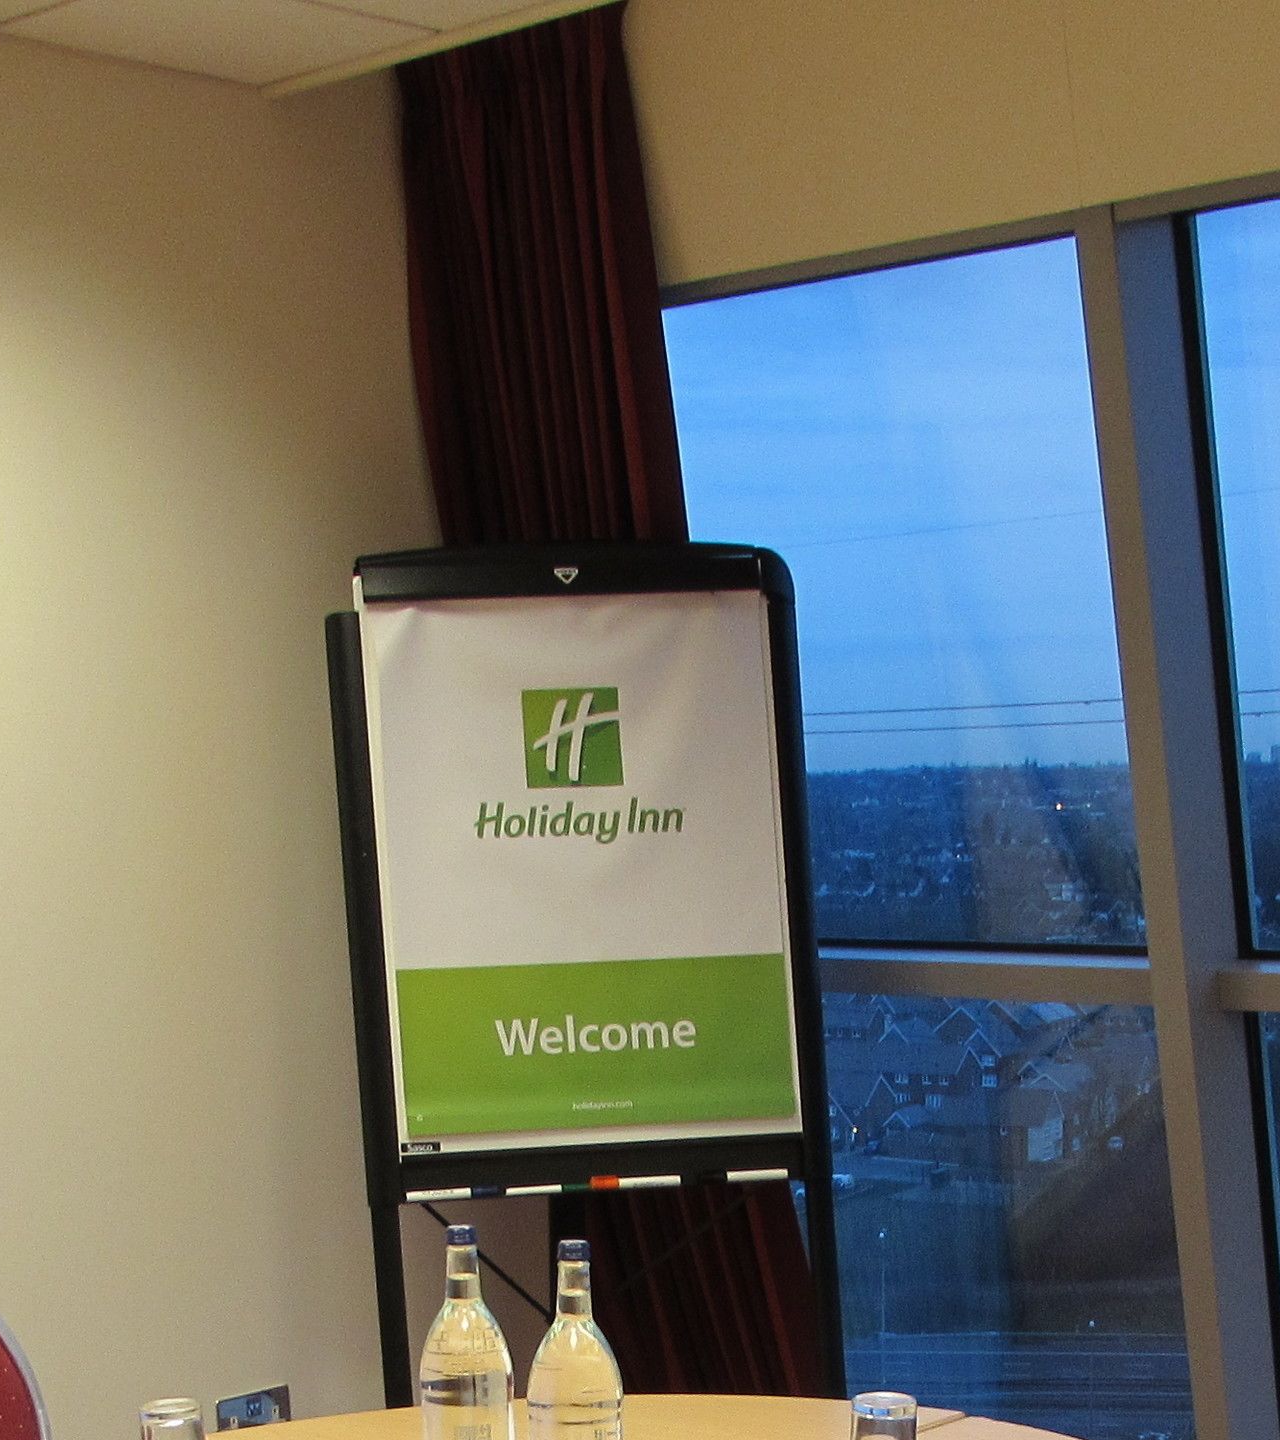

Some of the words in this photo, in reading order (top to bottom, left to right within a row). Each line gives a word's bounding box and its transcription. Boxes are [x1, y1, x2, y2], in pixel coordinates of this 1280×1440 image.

[474, 801, 621, 844] Holiday
[626, 796, 684, 834] Inn
[494, 1014, 697, 1057] Welcome
